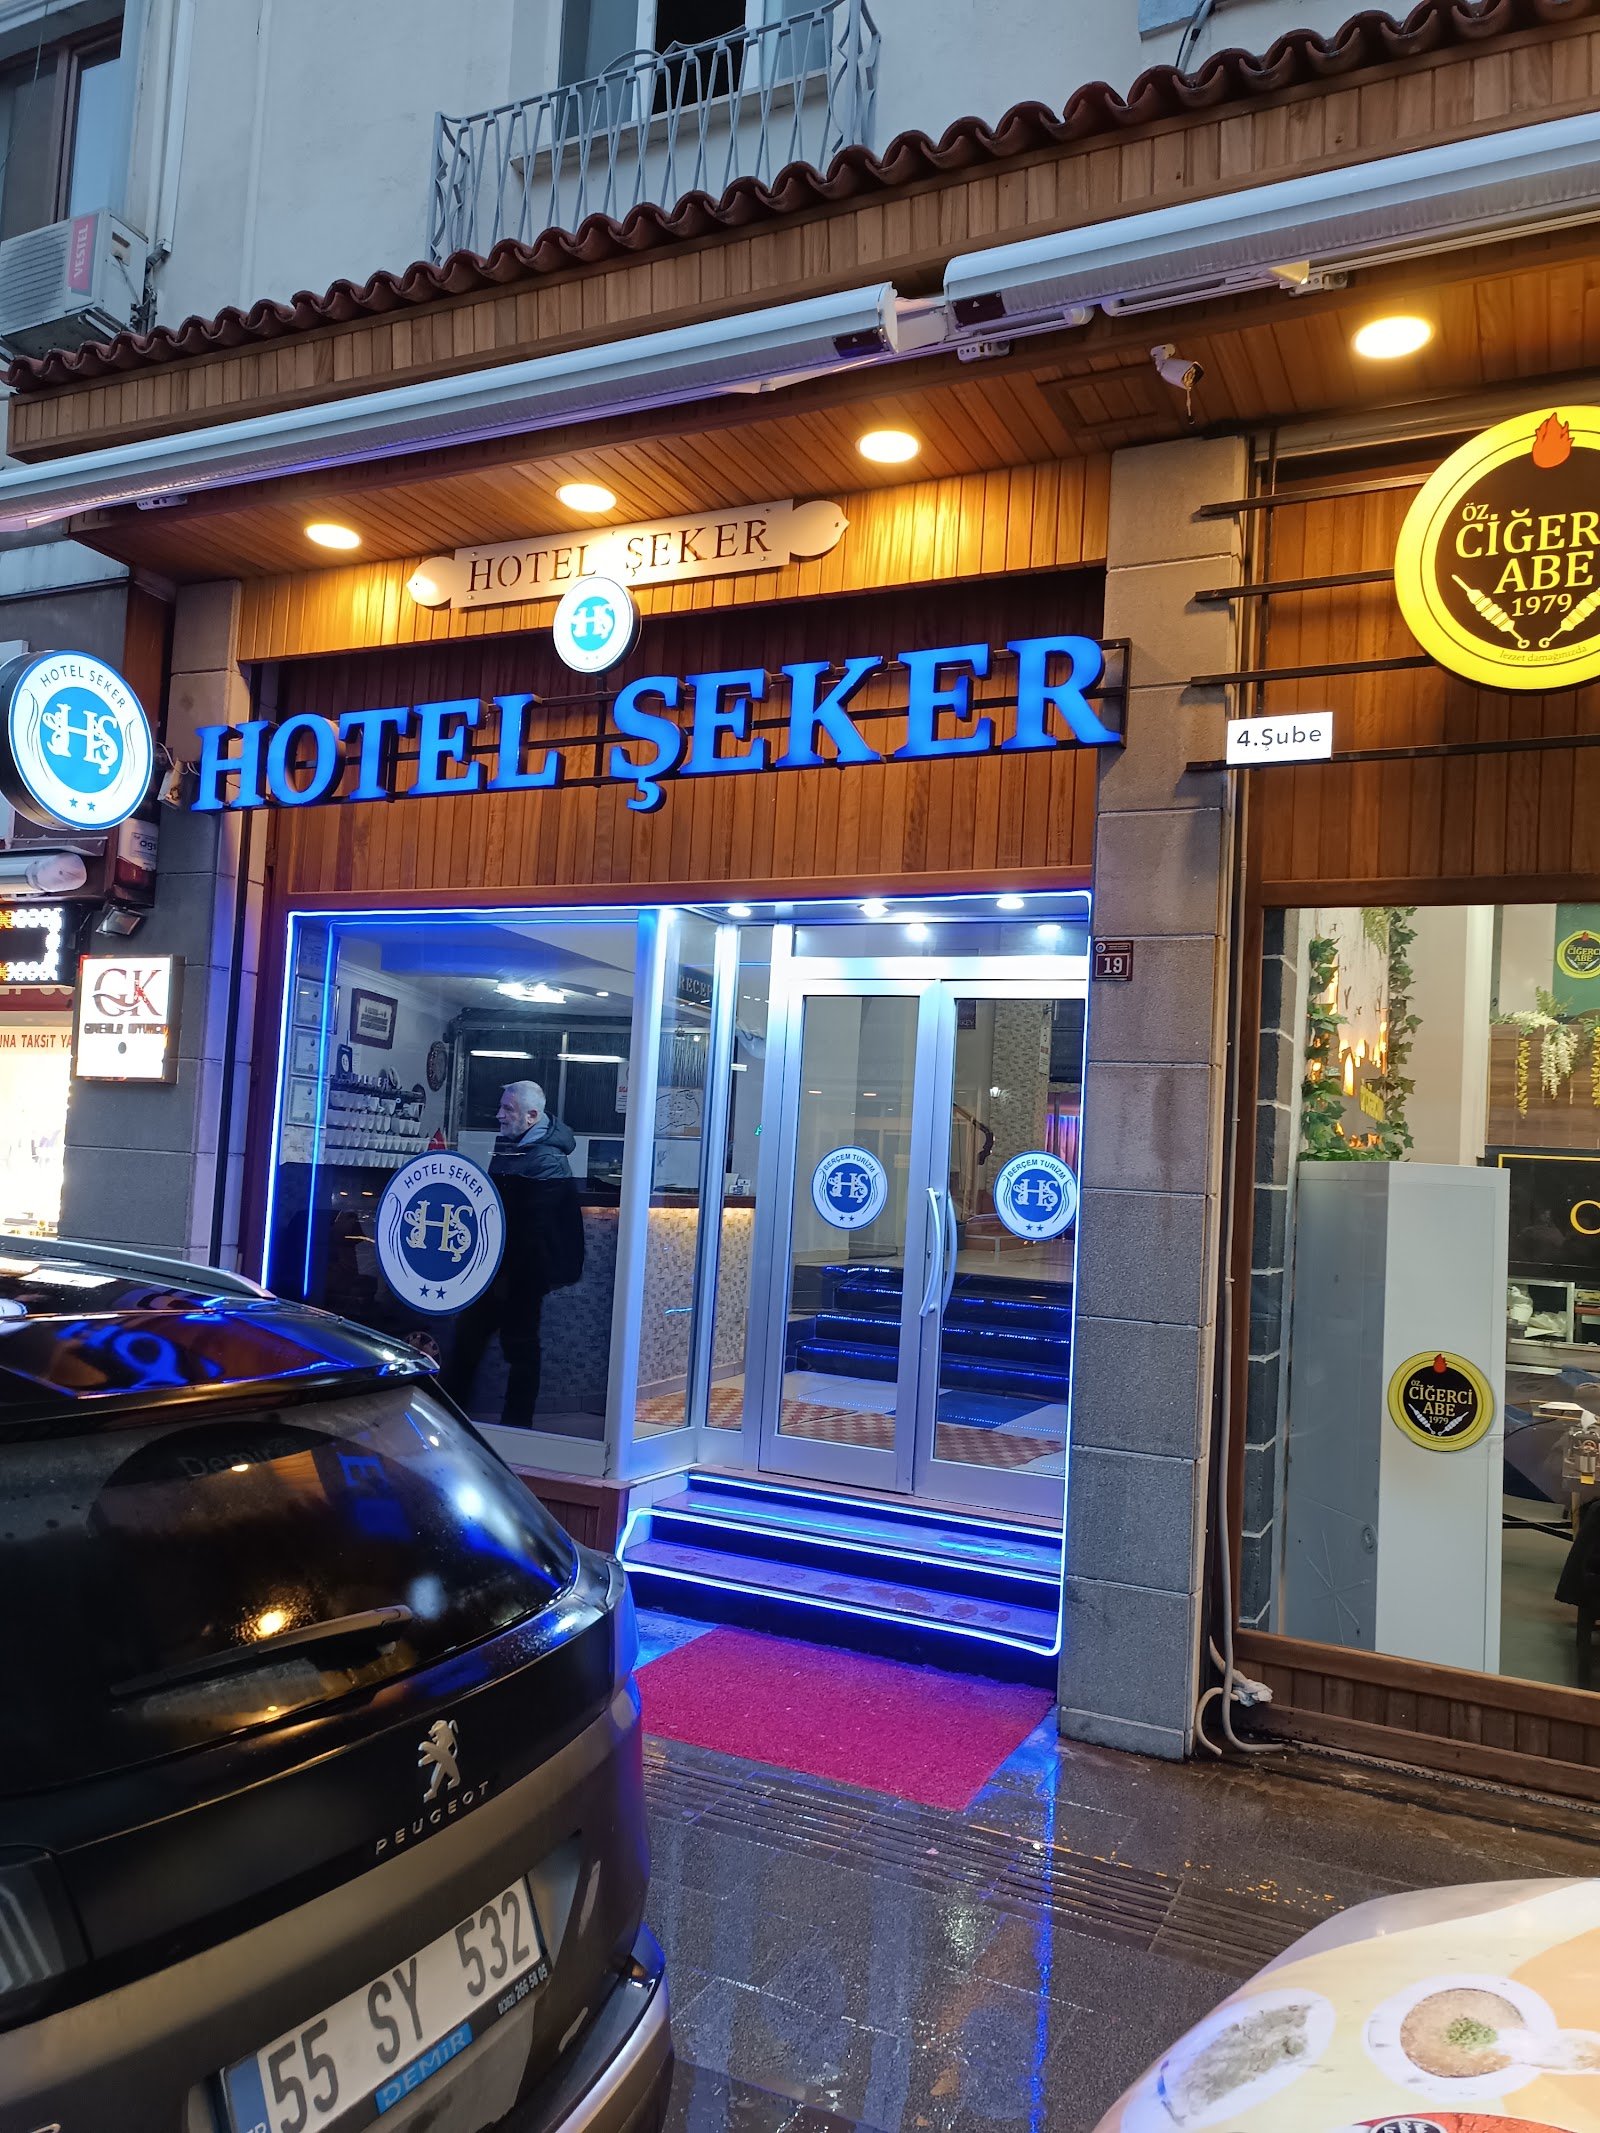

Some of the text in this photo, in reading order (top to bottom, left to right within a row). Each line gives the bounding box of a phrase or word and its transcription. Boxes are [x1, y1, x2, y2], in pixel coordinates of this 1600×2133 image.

[73, 223, 88, 279] VESTEL
[1462, 502, 1489, 521] ÖZ
[467, 519, 772, 592] HOTEL ŞEKER
[1493, 550, 1594, 594] ABE
[1511, 593, 1572, 617] 1979
[40, 664, 84, 688] HOTEL
[191, 636, 1122, 813] HOTEL ŞEKER
[1236, 725, 1322, 751] 4.Şube
[1103, 957, 1123, 974] 19
[92, 968, 162, 1017] GK
[0, 1034, 16, 1048] NA
[823, 1153, 876, 1173] BERÇEM TURİZM
[1007, 1159, 1066, 1180] BERÇEM TURİZM
[404, 1163, 483, 1198] HOTEL ŞEKER
[1409, 1384, 1473, 1405] CİĞERCİ
[1423, 1401, 1456, 1417] ABE
[1429, 1416, 1449, 1425] 1979
[375, 1781, 489, 1855] PEUGEOT
[268, 1891, 530, 2133] 55 SY 532
